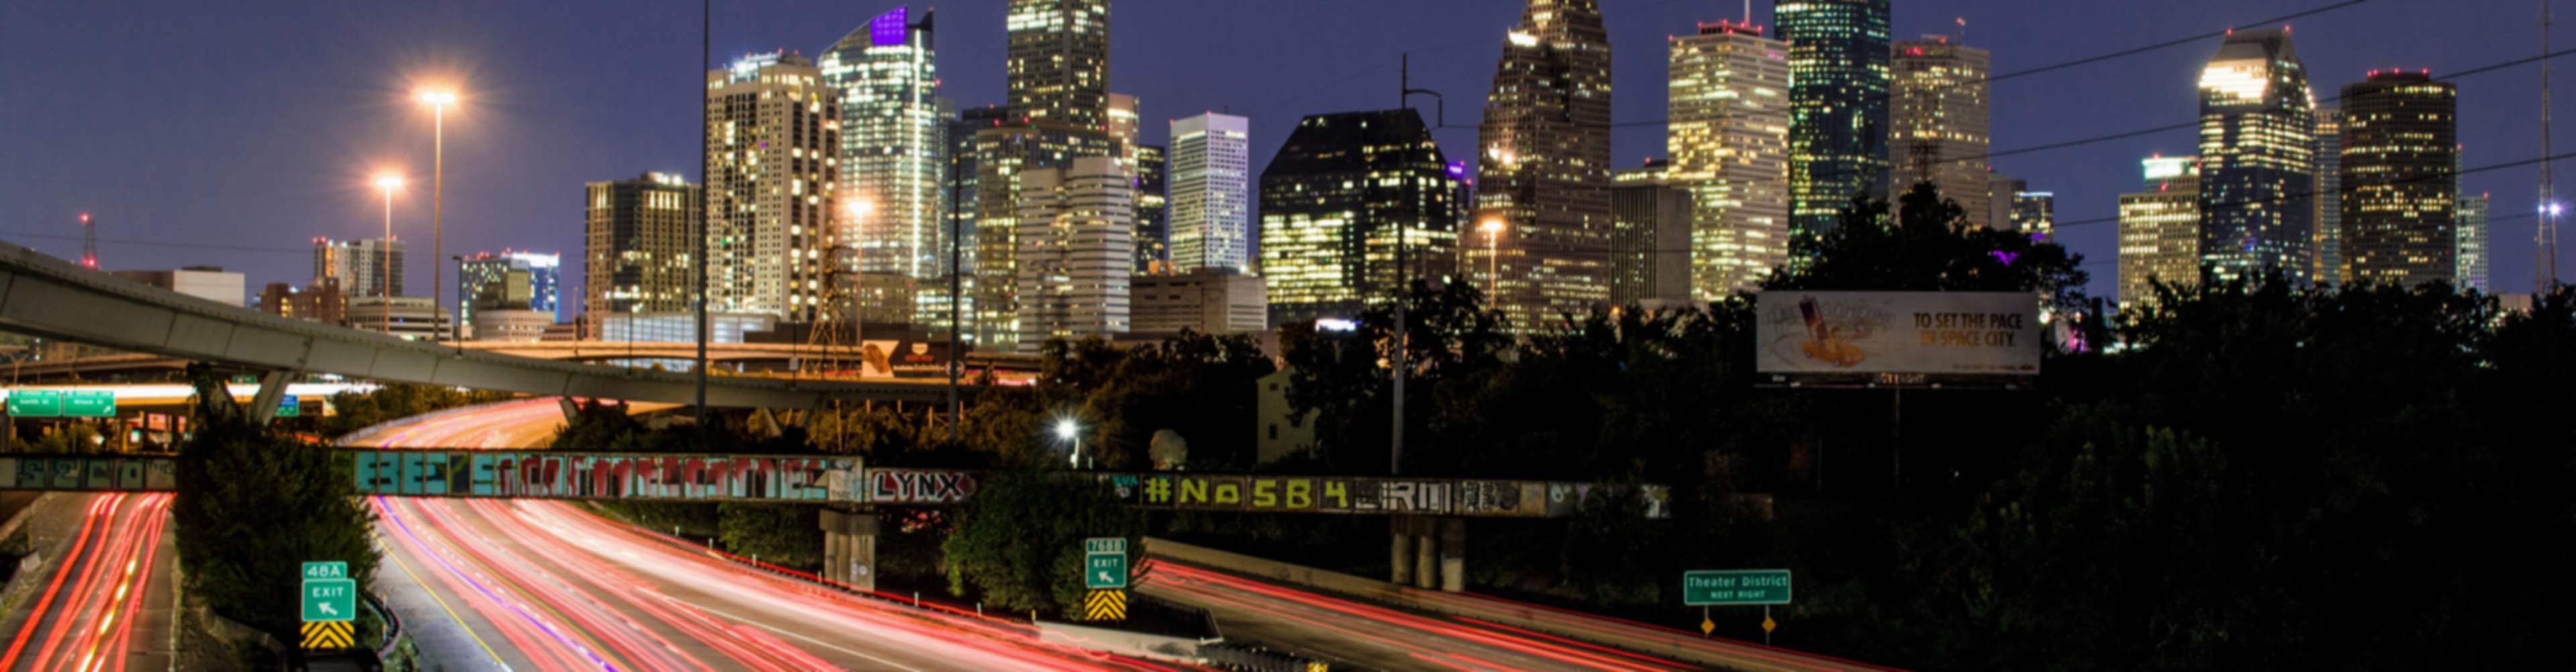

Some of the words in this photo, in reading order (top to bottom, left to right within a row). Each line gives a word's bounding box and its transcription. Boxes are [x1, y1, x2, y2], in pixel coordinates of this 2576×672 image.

[1913, 313, 1932, 328] TO
[1935, 313, 1958, 329] SET
[1961, 313, 1986, 329] THE
[1990, 313, 2023, 329] PACE
[1921, 331, 1935, 344] IN
[1941, 331, 1980, 346] SPACE
[873, 471, 965, 501] LYNX
[1094, 559, 1118, 567] EXIT
[307, 565, 341, 577] 48A
[1688, 576, 1736, 587] Theater
[1741, 575, 1787, 586] District
[313, 587, 343, 598] EXIT
[1711, 590, 1734, 599] NEXT
[1737, 590, 1766, 598] RIGHT
